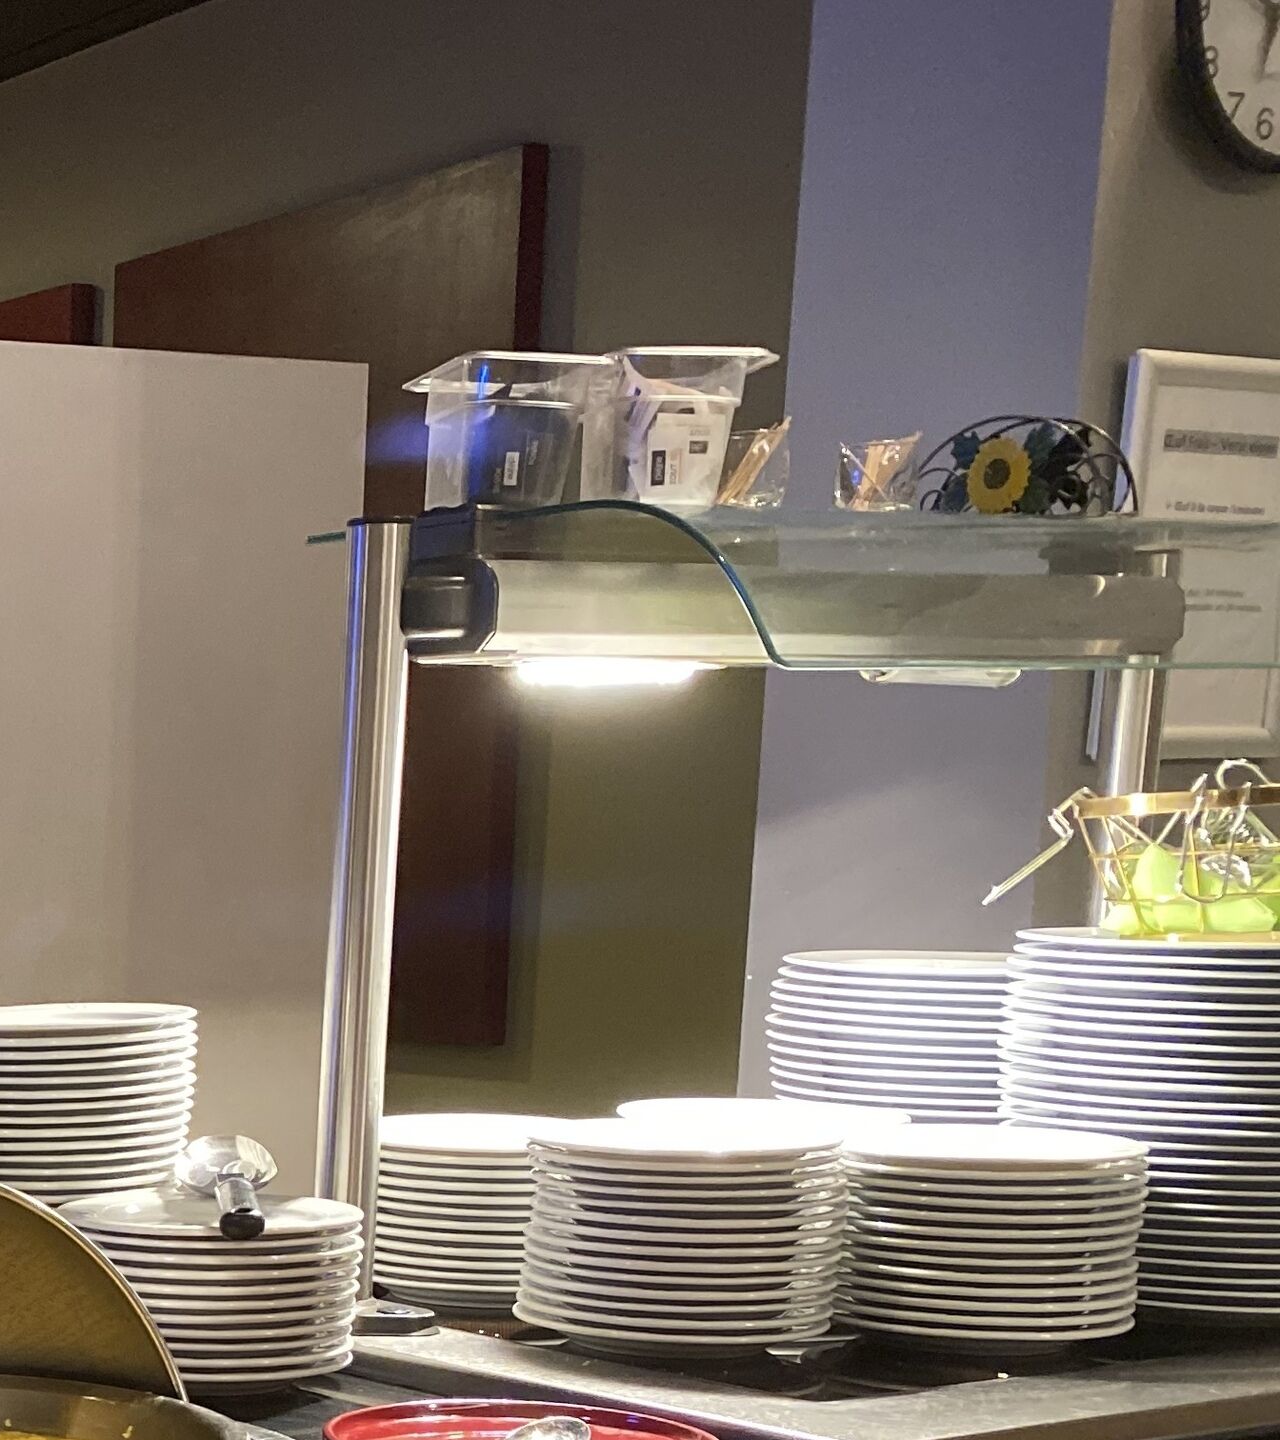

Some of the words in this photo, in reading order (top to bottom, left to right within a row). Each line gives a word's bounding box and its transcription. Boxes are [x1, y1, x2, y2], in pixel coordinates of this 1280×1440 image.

[1204, 45, 1218, 79] 8
[1227, 91, 1245, 121] 7
[1256, 107, 1275, 140] 6
